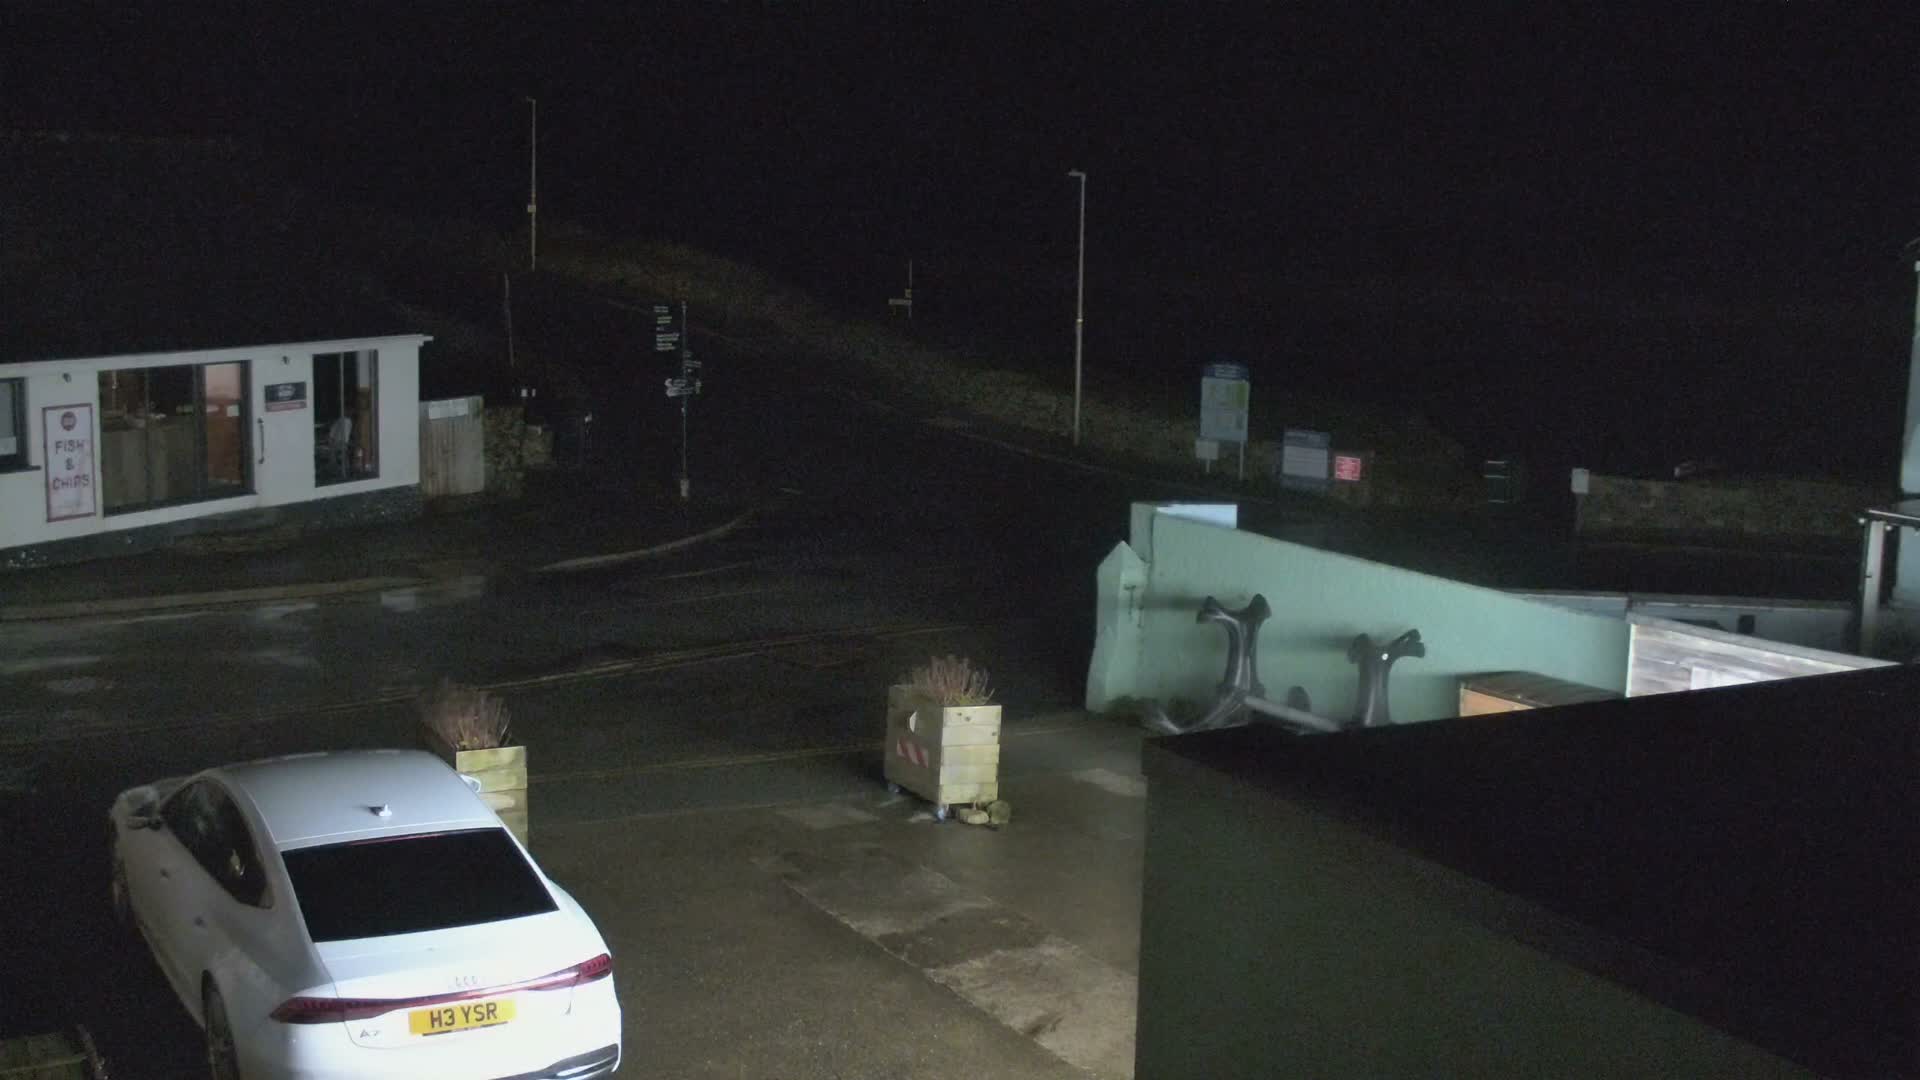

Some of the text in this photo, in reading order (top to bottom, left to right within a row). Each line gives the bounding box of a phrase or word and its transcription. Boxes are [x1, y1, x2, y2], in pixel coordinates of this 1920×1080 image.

[55, 439, 85, 454] FISH
[65, 457, 75, 471] &
[53, 474, 90, 490] CHIPS
[430, 1002, 497, 1028] H3 YSR
